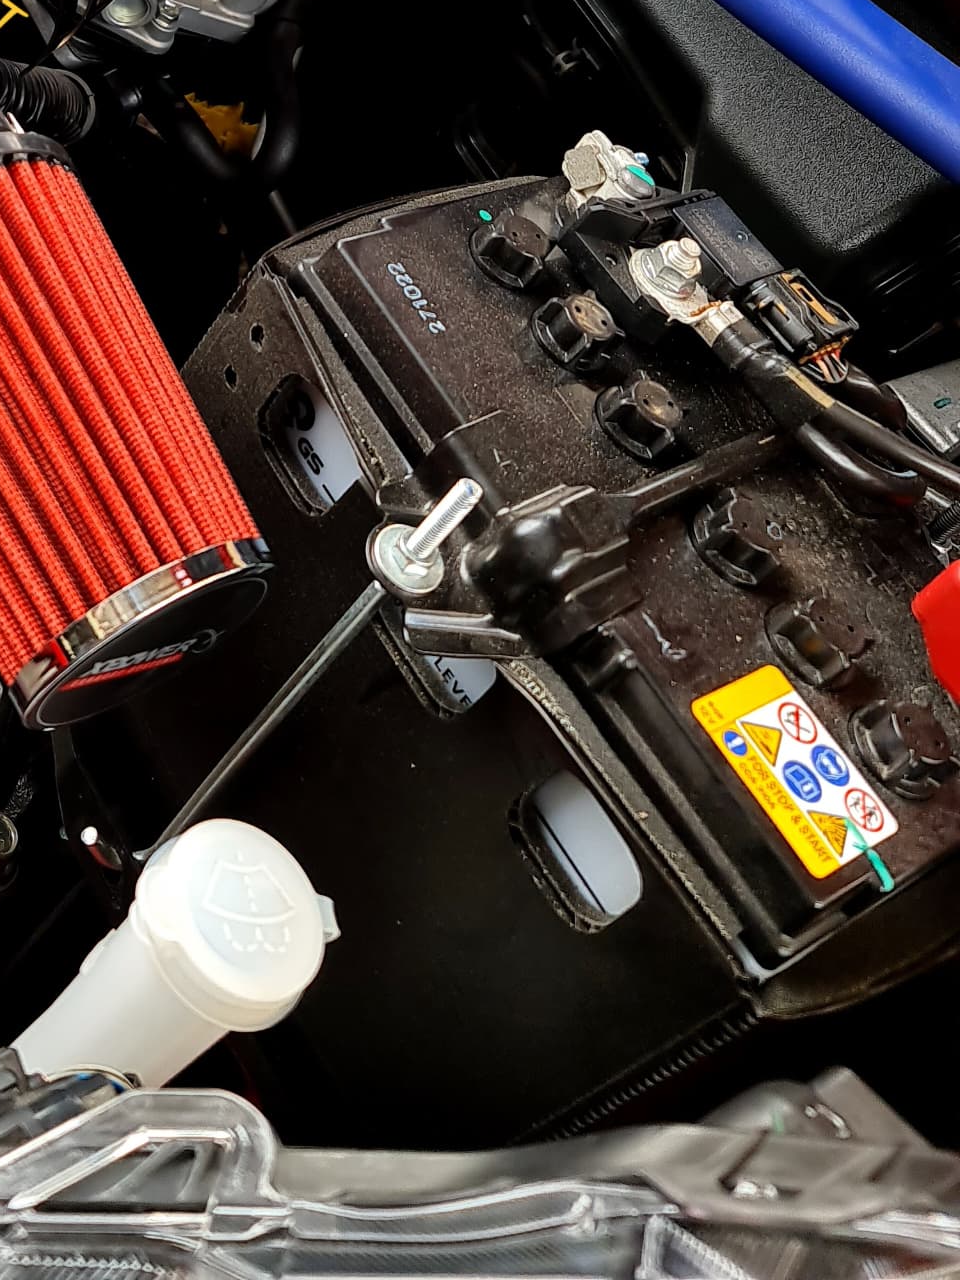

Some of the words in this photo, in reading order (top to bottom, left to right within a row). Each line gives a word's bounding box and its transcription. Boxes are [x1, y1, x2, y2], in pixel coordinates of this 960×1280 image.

[387, 262, 446, 334] 271022
[298, 437, 324, 475] GS
[434, 655, 473, 706] LEVE
[747, 756, 769, 780] FOR
[767, 781, 794, 811] STOP
[799, 825, 832, 862] START
